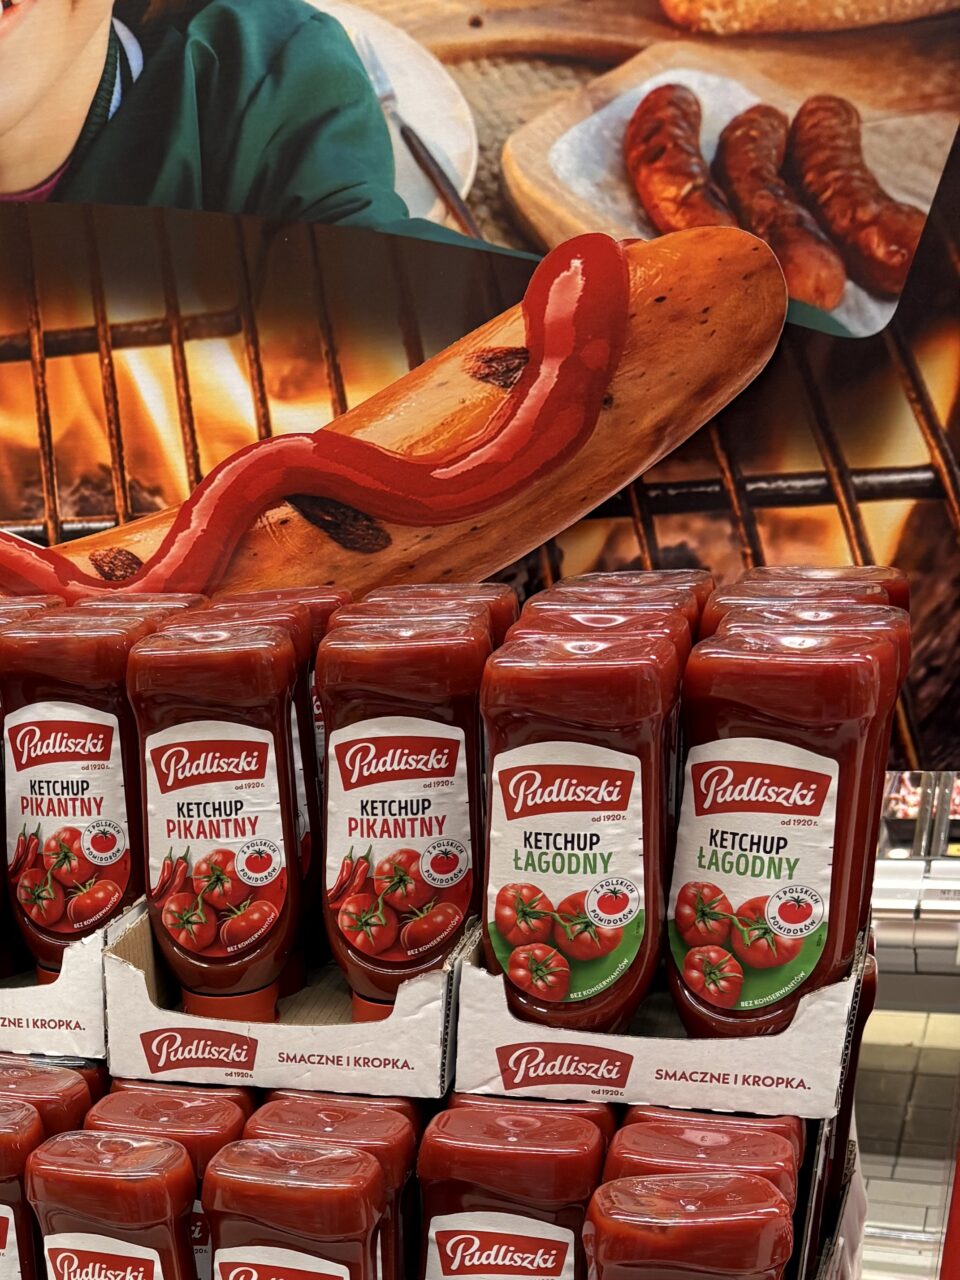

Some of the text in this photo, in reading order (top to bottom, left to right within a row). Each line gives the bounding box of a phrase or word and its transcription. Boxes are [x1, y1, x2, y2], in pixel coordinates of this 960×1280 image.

[161, 747, 259, 787] Pudliszki
[509, 770, 623, 813] Pudliszki
[700, 766, 818, 809] Pudliszki
[176, 800, 244, 819] KETCHUP
[166, 816, 259, 839] PIKANTNY
[523, 831, 601, 851] KETCHUP
[709, 828, 788, 855] KETCHUP
[513, 849, 613, 875] ŁAGODNY
[697, 846, 800, 881] ŁAGODNY
[782, 888, 820, 906] POLSKICH
[589, 908, 634, 926] POMIDORÓW
[769, 915, 818, 936] POMIDORÓW
[741, 971, 806, 1007] BEZ KONSERWANTÓW
[152, 1032, 248, 1066] Pudliszki
[278, 1052, 415, 1071] SMACZNE I KROPKA.
[508, 1047, 622, 1084] Pudliszki
[655, 1069, 812, 1090] SMACZNE I KROPKA.
[445, 1234, 559, 1271] Pudliszki
